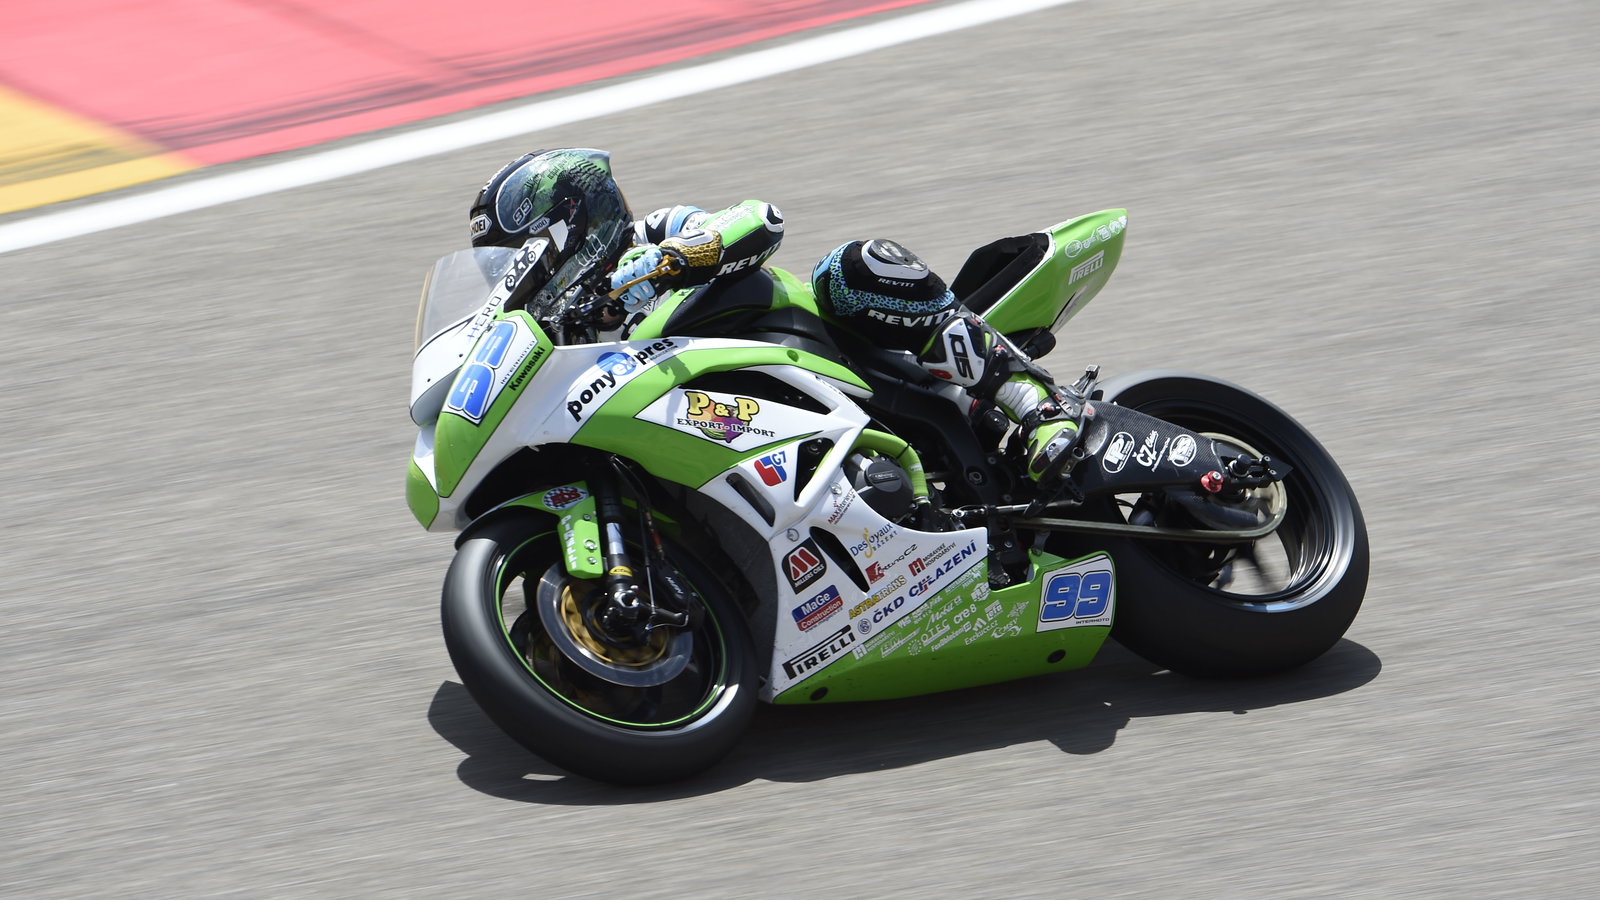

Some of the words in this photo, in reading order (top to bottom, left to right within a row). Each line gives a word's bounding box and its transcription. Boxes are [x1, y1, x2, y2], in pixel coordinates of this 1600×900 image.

[1068, 250, 1105, 285] PIRELLI
[509, 346, 546, 391] Kawasaki
[800, 592, 831, 615] MaGe
[801, 600, 841, 629] Construction
[849, 575, 908, 619] ASTRATRANS
[873, 595, 905, 624] ČKD
[1041, 570, 1112, 622] 99
[782, 624, 856, 680] PIRELLI
